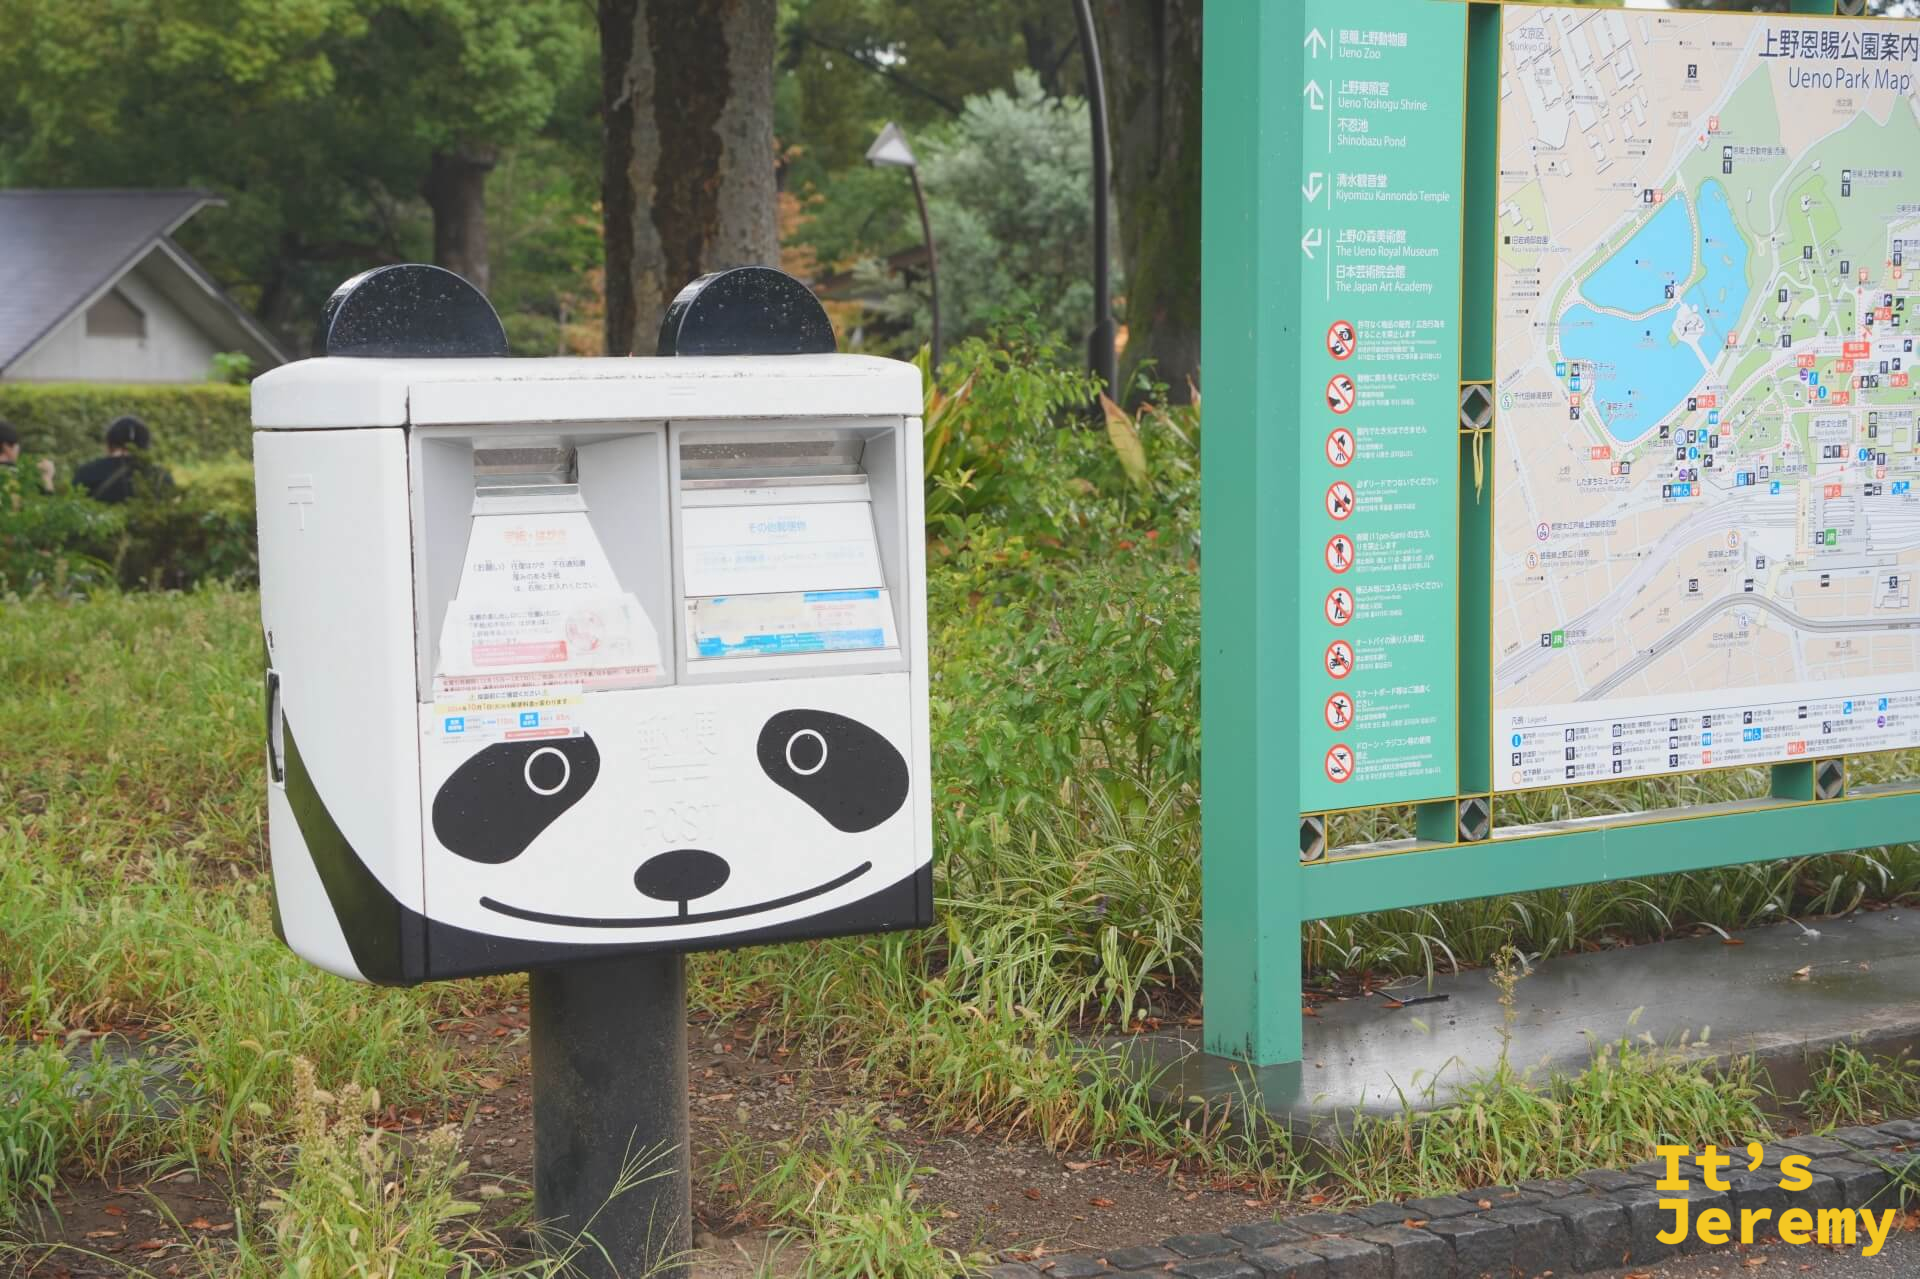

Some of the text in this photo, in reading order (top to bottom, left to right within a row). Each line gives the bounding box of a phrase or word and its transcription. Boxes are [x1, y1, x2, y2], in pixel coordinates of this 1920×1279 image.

[1520, 27, 1545, 40] 文京区
[1339, 47, 1382, 60] Ueno Zoo
[1758, 28, 1920, 64] 上野恩賜公園案内
[1788, 66, 1910, 94] Ueno Park Map
[1338, 80, 1390, 96] 上野東照宮
[1338, 97, 1428, 113] Ueno Toshogu Shrine
[1337, 118, 1369, 133] 不忍池
[1337, 135, 1407, 148] Shinobazu Pond
[1336, 191, 1451, 204] Kiyomizu Kannondo Temple
[1336, 229, 1407, 244] 上野の森美術館
[1336, 245, 1439, 259] The Ueno Royal Museum
[1336, 264, 1407, 280] 日本芸術院会館
[1336, 280, 1433, 295] The Japan Art Academy
